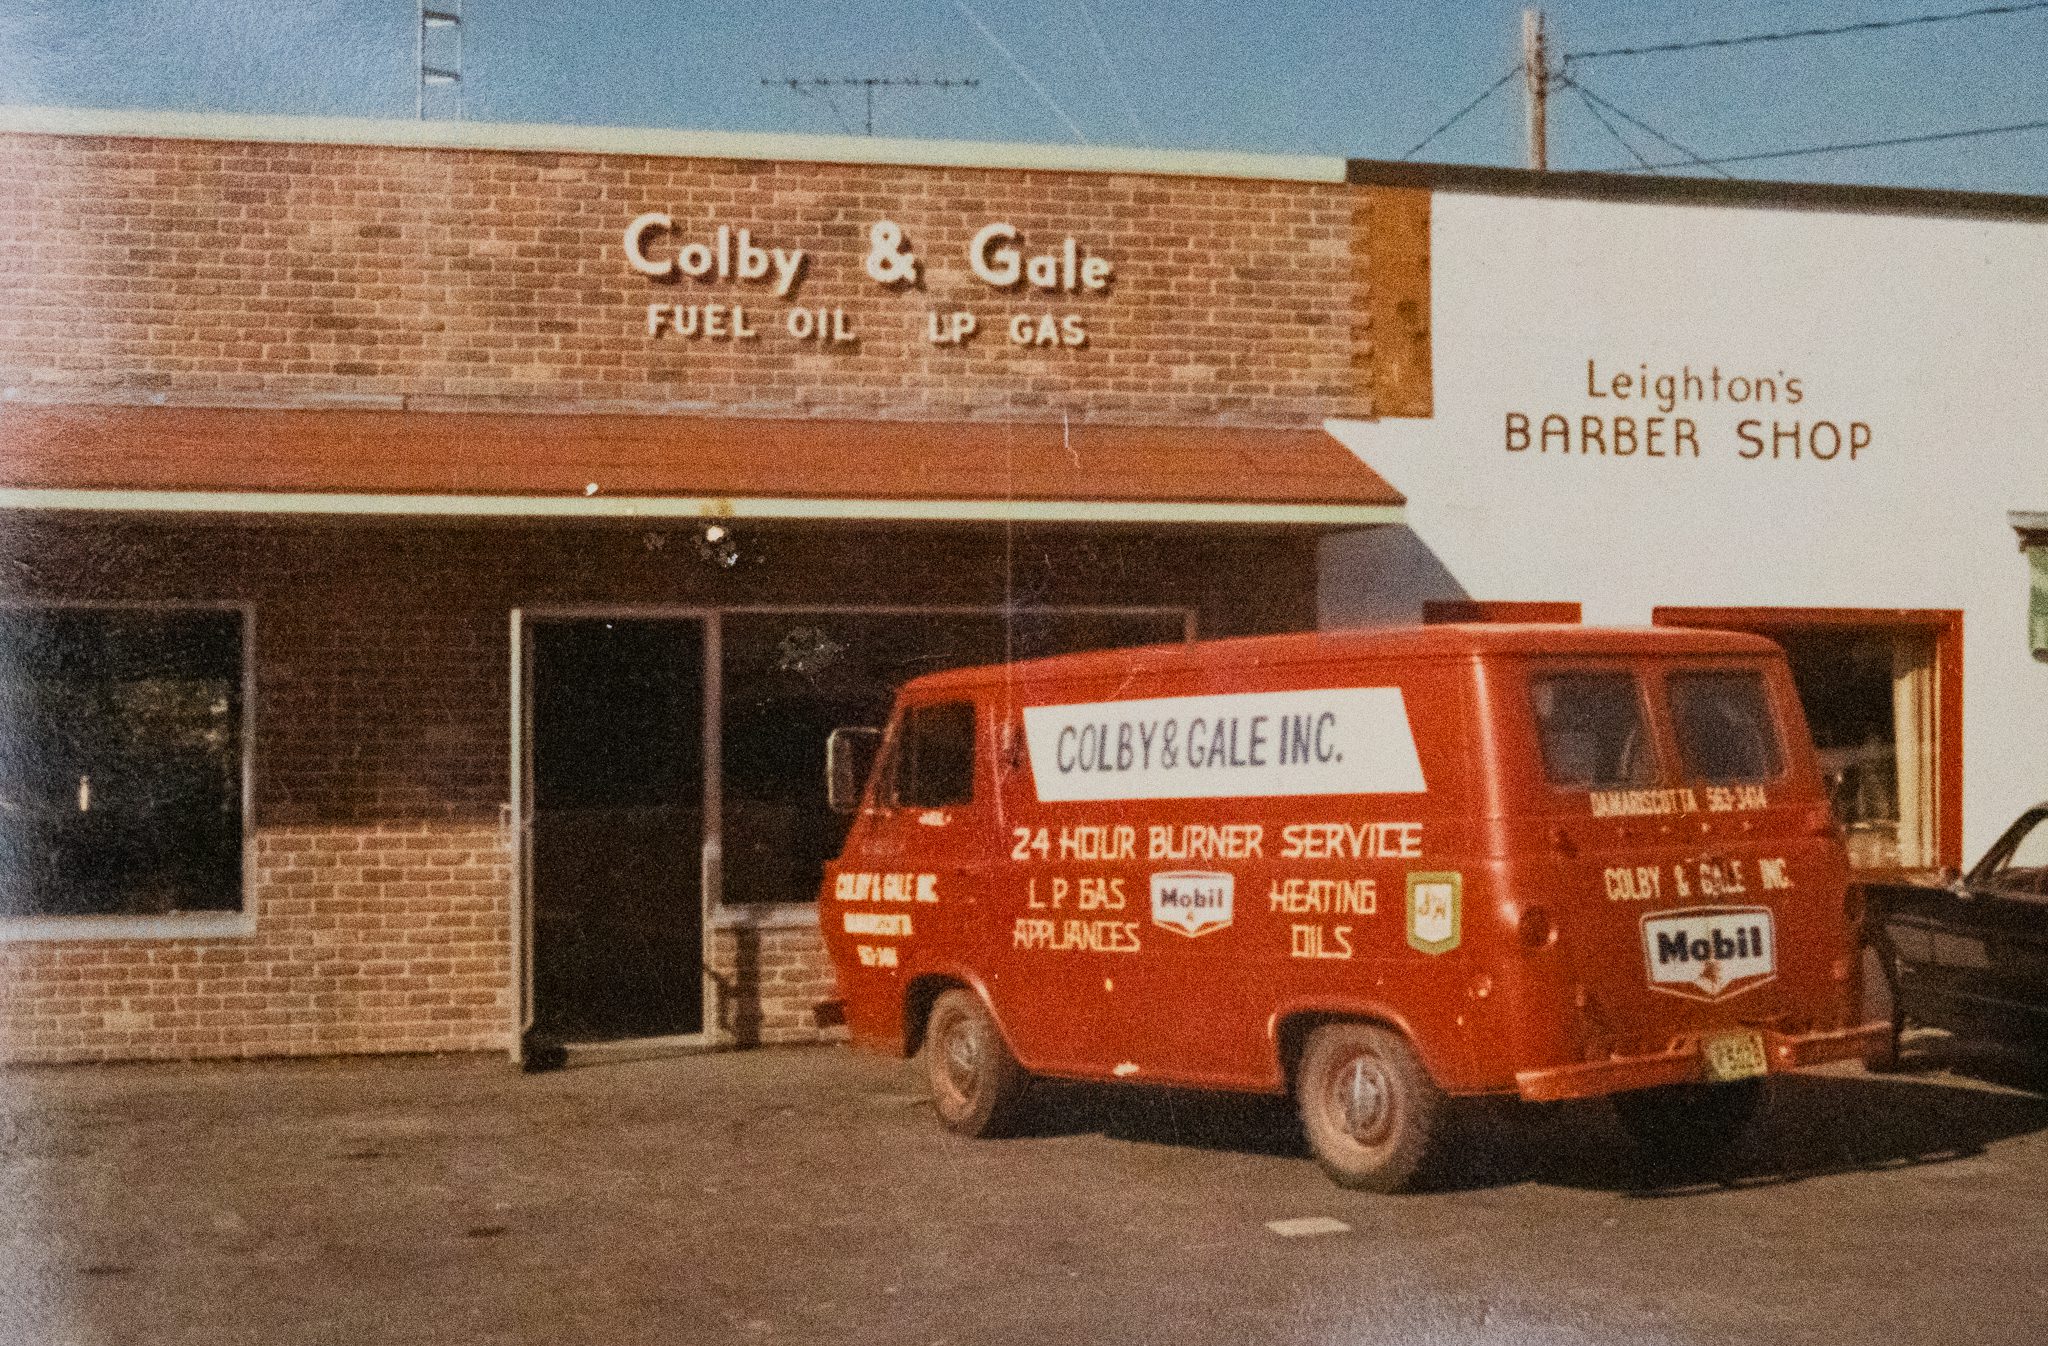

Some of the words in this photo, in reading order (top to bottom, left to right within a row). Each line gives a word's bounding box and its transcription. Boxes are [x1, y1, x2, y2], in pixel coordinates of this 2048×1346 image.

[624, 213, 802, 296] Colby
[866, 220, 918, 284] &
[970, 223, 1111, 289] Gale
[647, 304, 756, 338] FUEL
[787, 308, 856, 341] OIL
[929, 312, 977, 344] LP
[1010, 314, 1087, 346] GAS
[1587, 359, 1804, 413] Leighton's
[1505, 412, 1700, 458] BARBER
[1737, 420, 1872, 461] SHOP
[1279, 712, 1343, 766] INC.
[1011, 827, 1050, 861] 24
[1059, 826, 1137, 860] HOUR
[1148, 823, 1264, 859] BURNER
[1281, 822, 1424, 859] SERVICE
[1078, 878, 1126, 910] GAS
[1158, 887, 1225, 909] Mobil
[1270, 879, 1377, 915] HEATING
[1605, 866, 1661, 901] COLBY
[1012, 920, 1141, 953] APPLIANCES
[1290, 925, 1353, 960] OILS
[1656, 926, 1762, 965] Mobil
